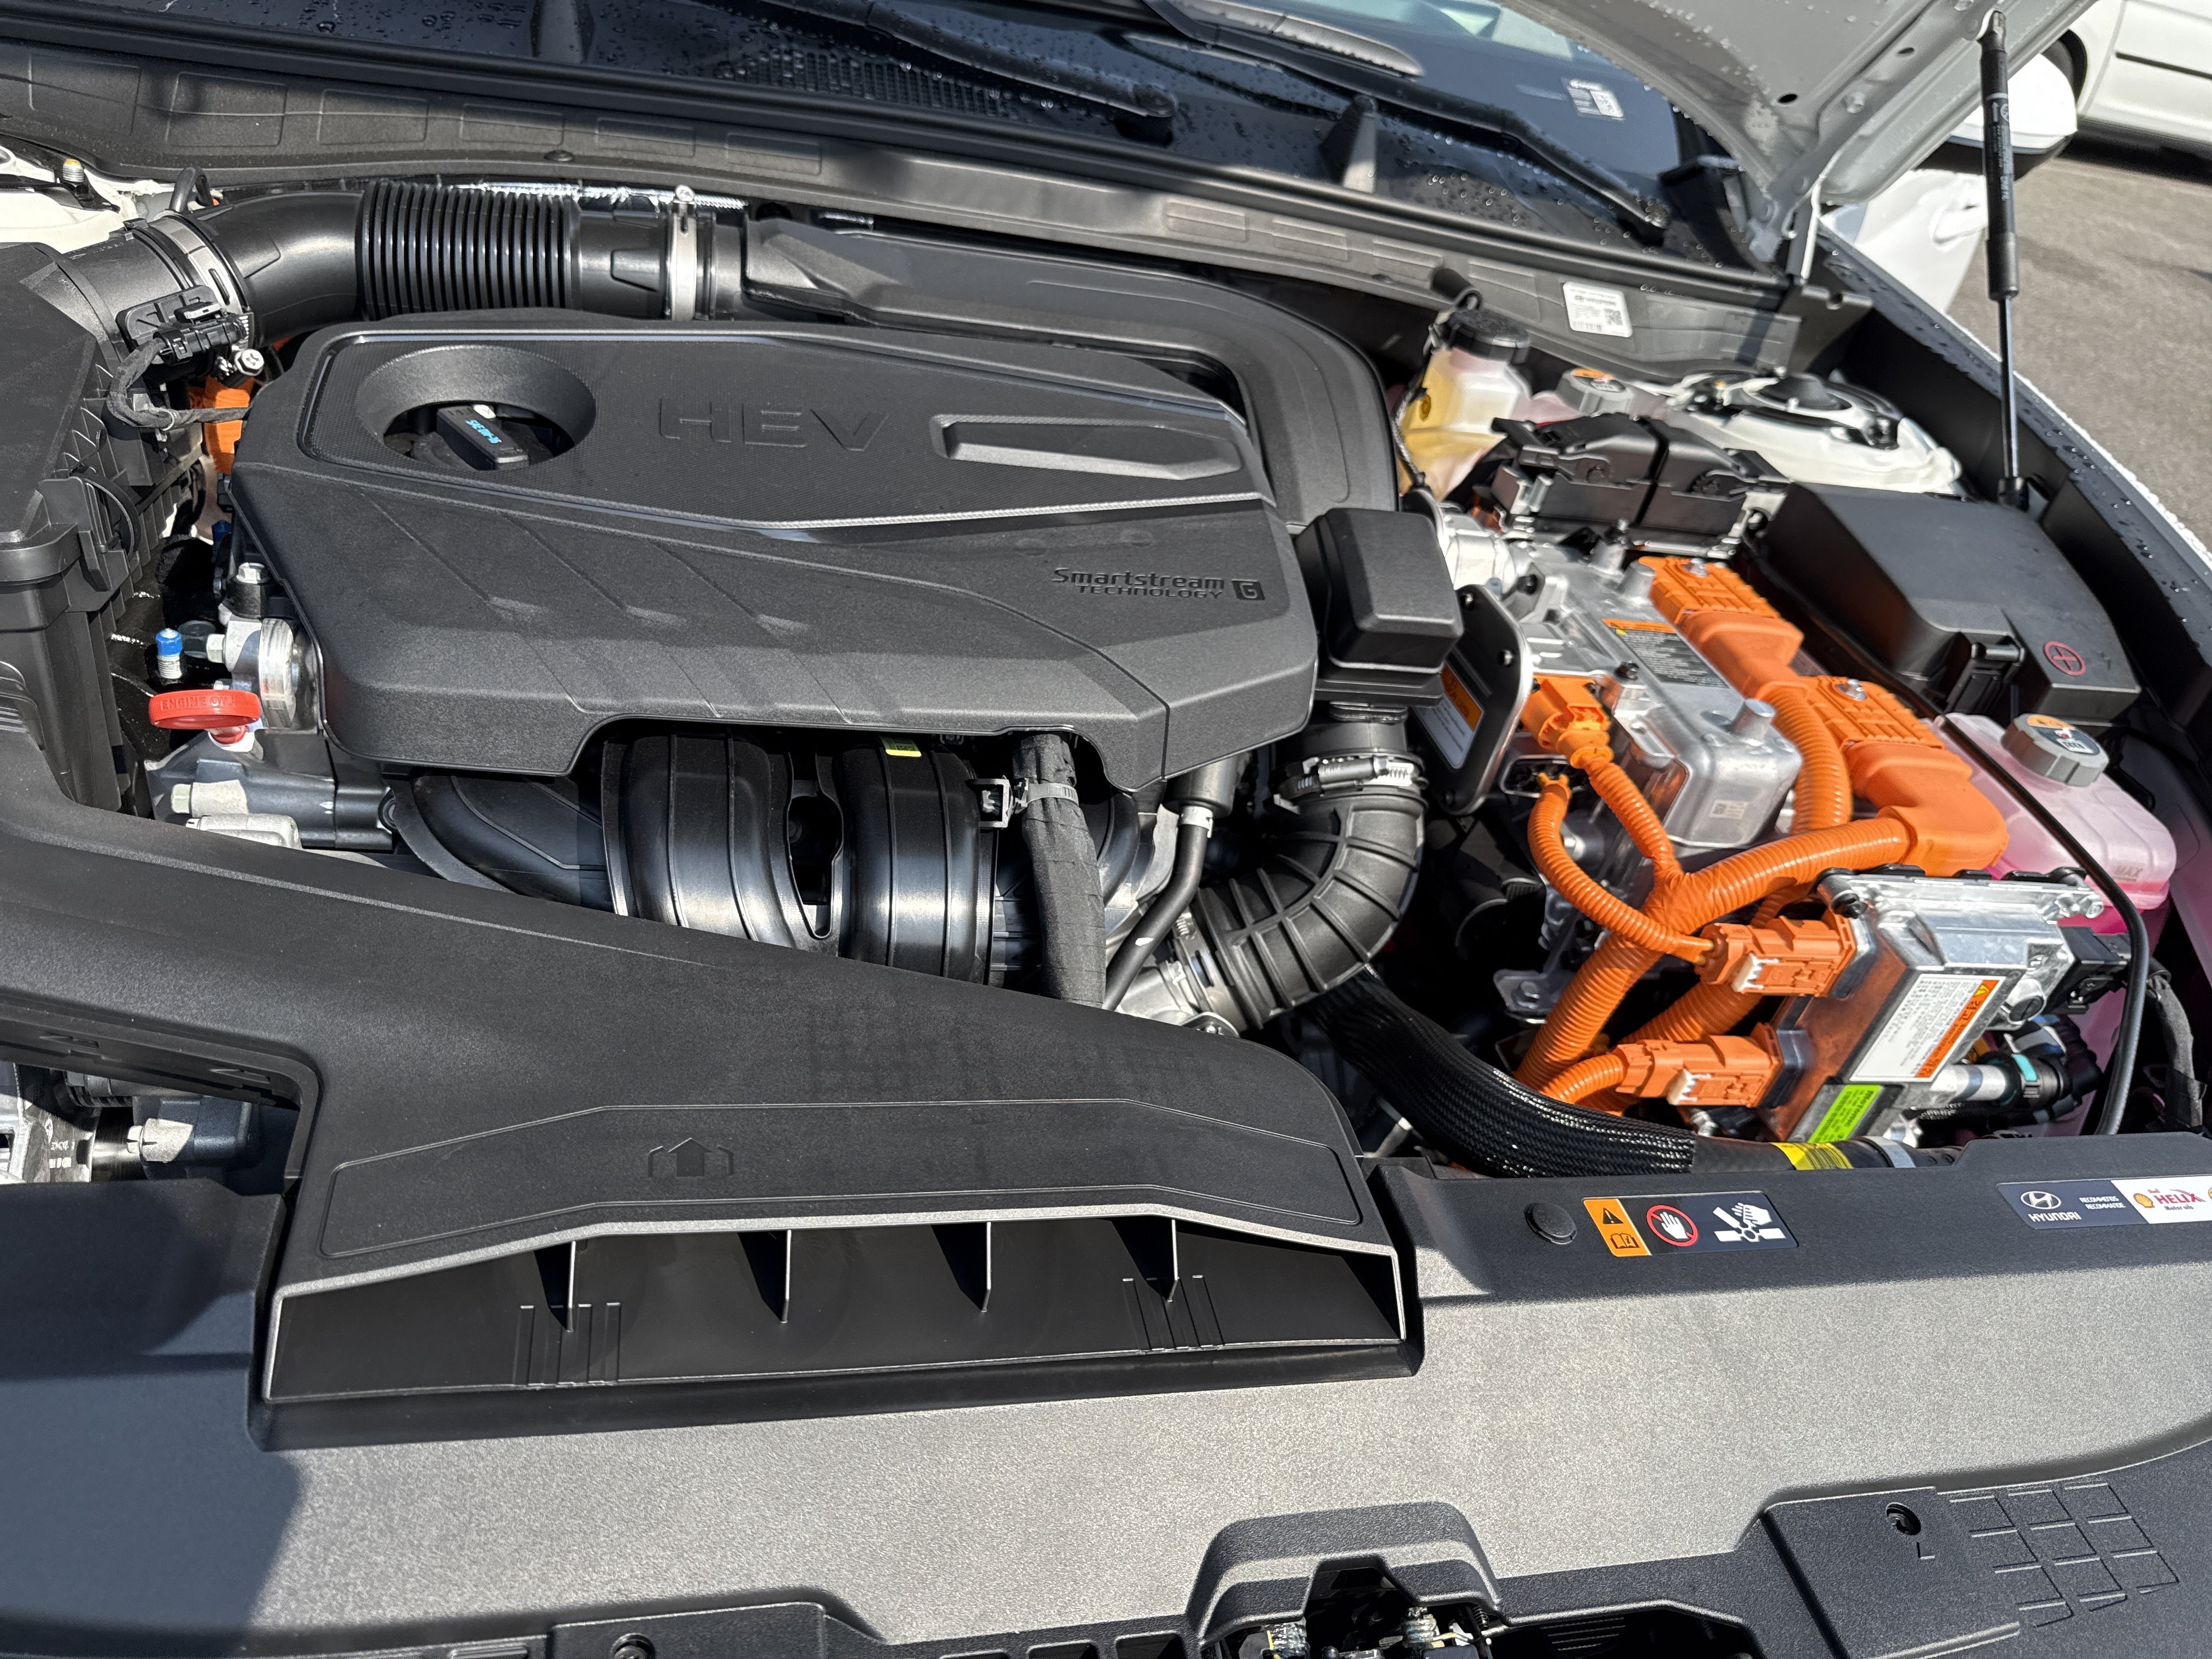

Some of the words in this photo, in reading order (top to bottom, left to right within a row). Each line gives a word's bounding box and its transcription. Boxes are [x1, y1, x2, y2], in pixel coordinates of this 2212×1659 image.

[659, 396, 889, 452] HEV
[1051, 567, 1224, 589] Smartstream
[1075, 584, 1223, 599] TECHNOLOGY
[160, 696, 206, 712] ENGINE
[210, 696, 234, 708] OIL
[2153, 1193, 2203, 1204] HELIX
[2028, 1211, 2083, 1222] HYUNDAI
